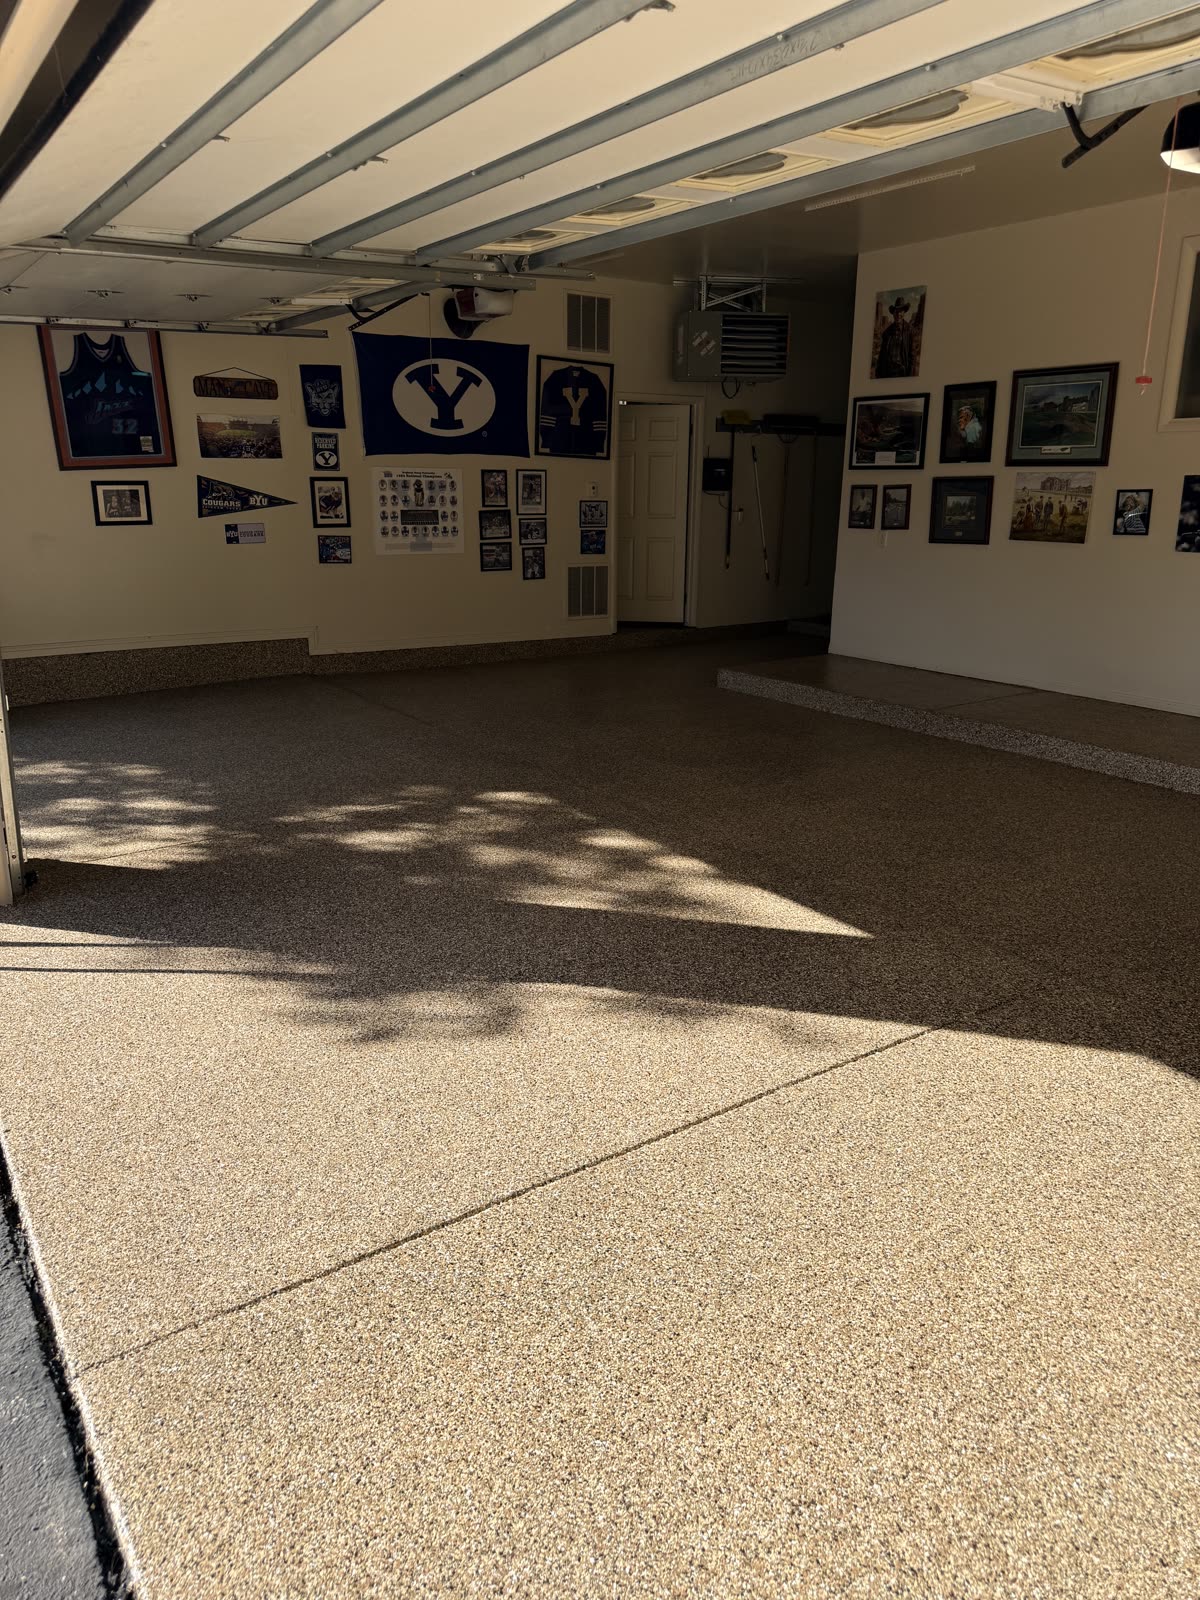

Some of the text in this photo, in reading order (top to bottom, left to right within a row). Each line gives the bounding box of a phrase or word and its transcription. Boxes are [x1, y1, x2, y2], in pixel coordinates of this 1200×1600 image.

[405, 363, 483, 430] Y
[562, 387, 590, 426] Y
[111, 417, 138, 435] 32
[318, 452, 335, 466] Y
[202, 498, 241, 507] COUGARS
[249, 494, 268, 506] BYU
